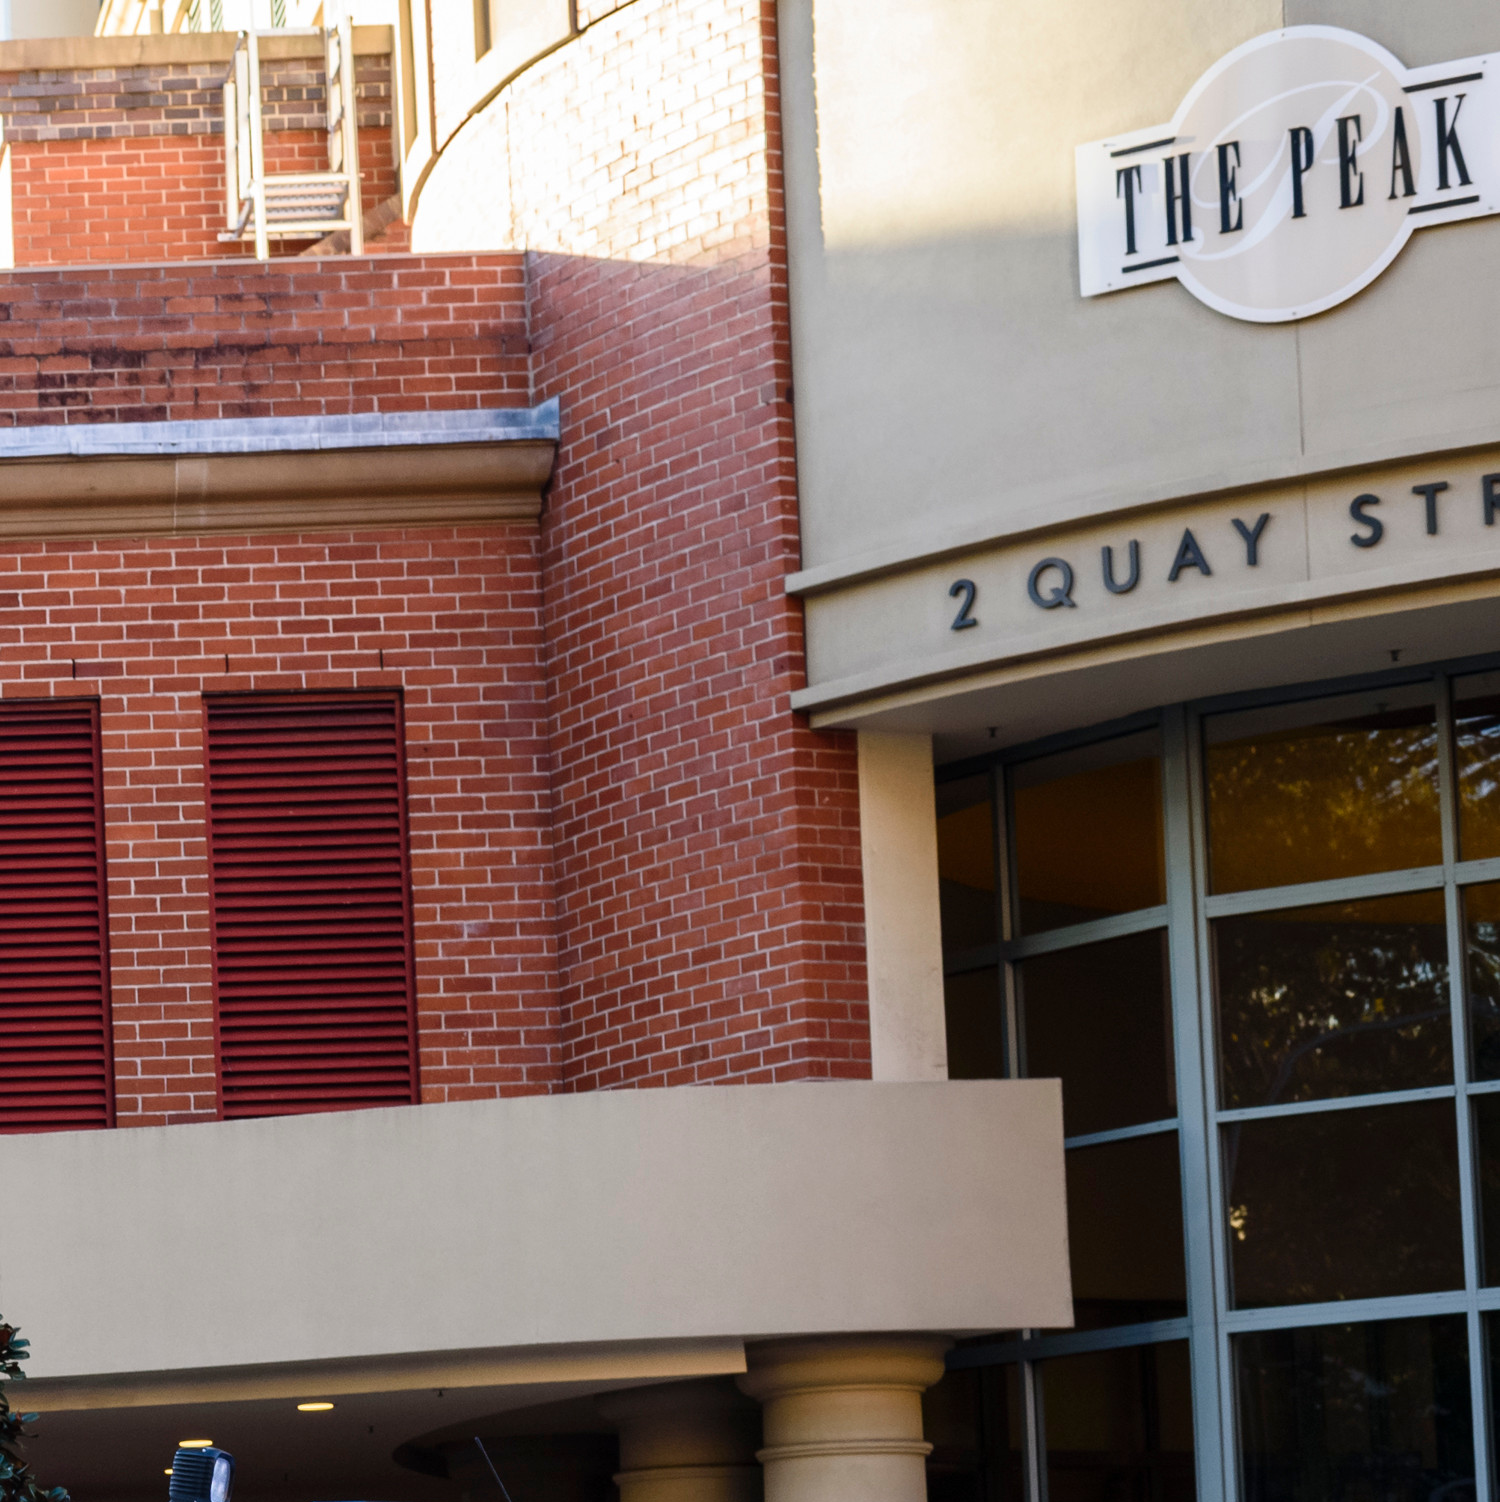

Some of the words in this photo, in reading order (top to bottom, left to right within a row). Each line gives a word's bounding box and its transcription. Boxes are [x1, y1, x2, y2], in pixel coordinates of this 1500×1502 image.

[1116, 140, 1243, 256] THE
[1287, 93, 1474, 220] PEAK
[948, 579, 977, 630] 2
[1026, 512, 1270, 611] QUAY
